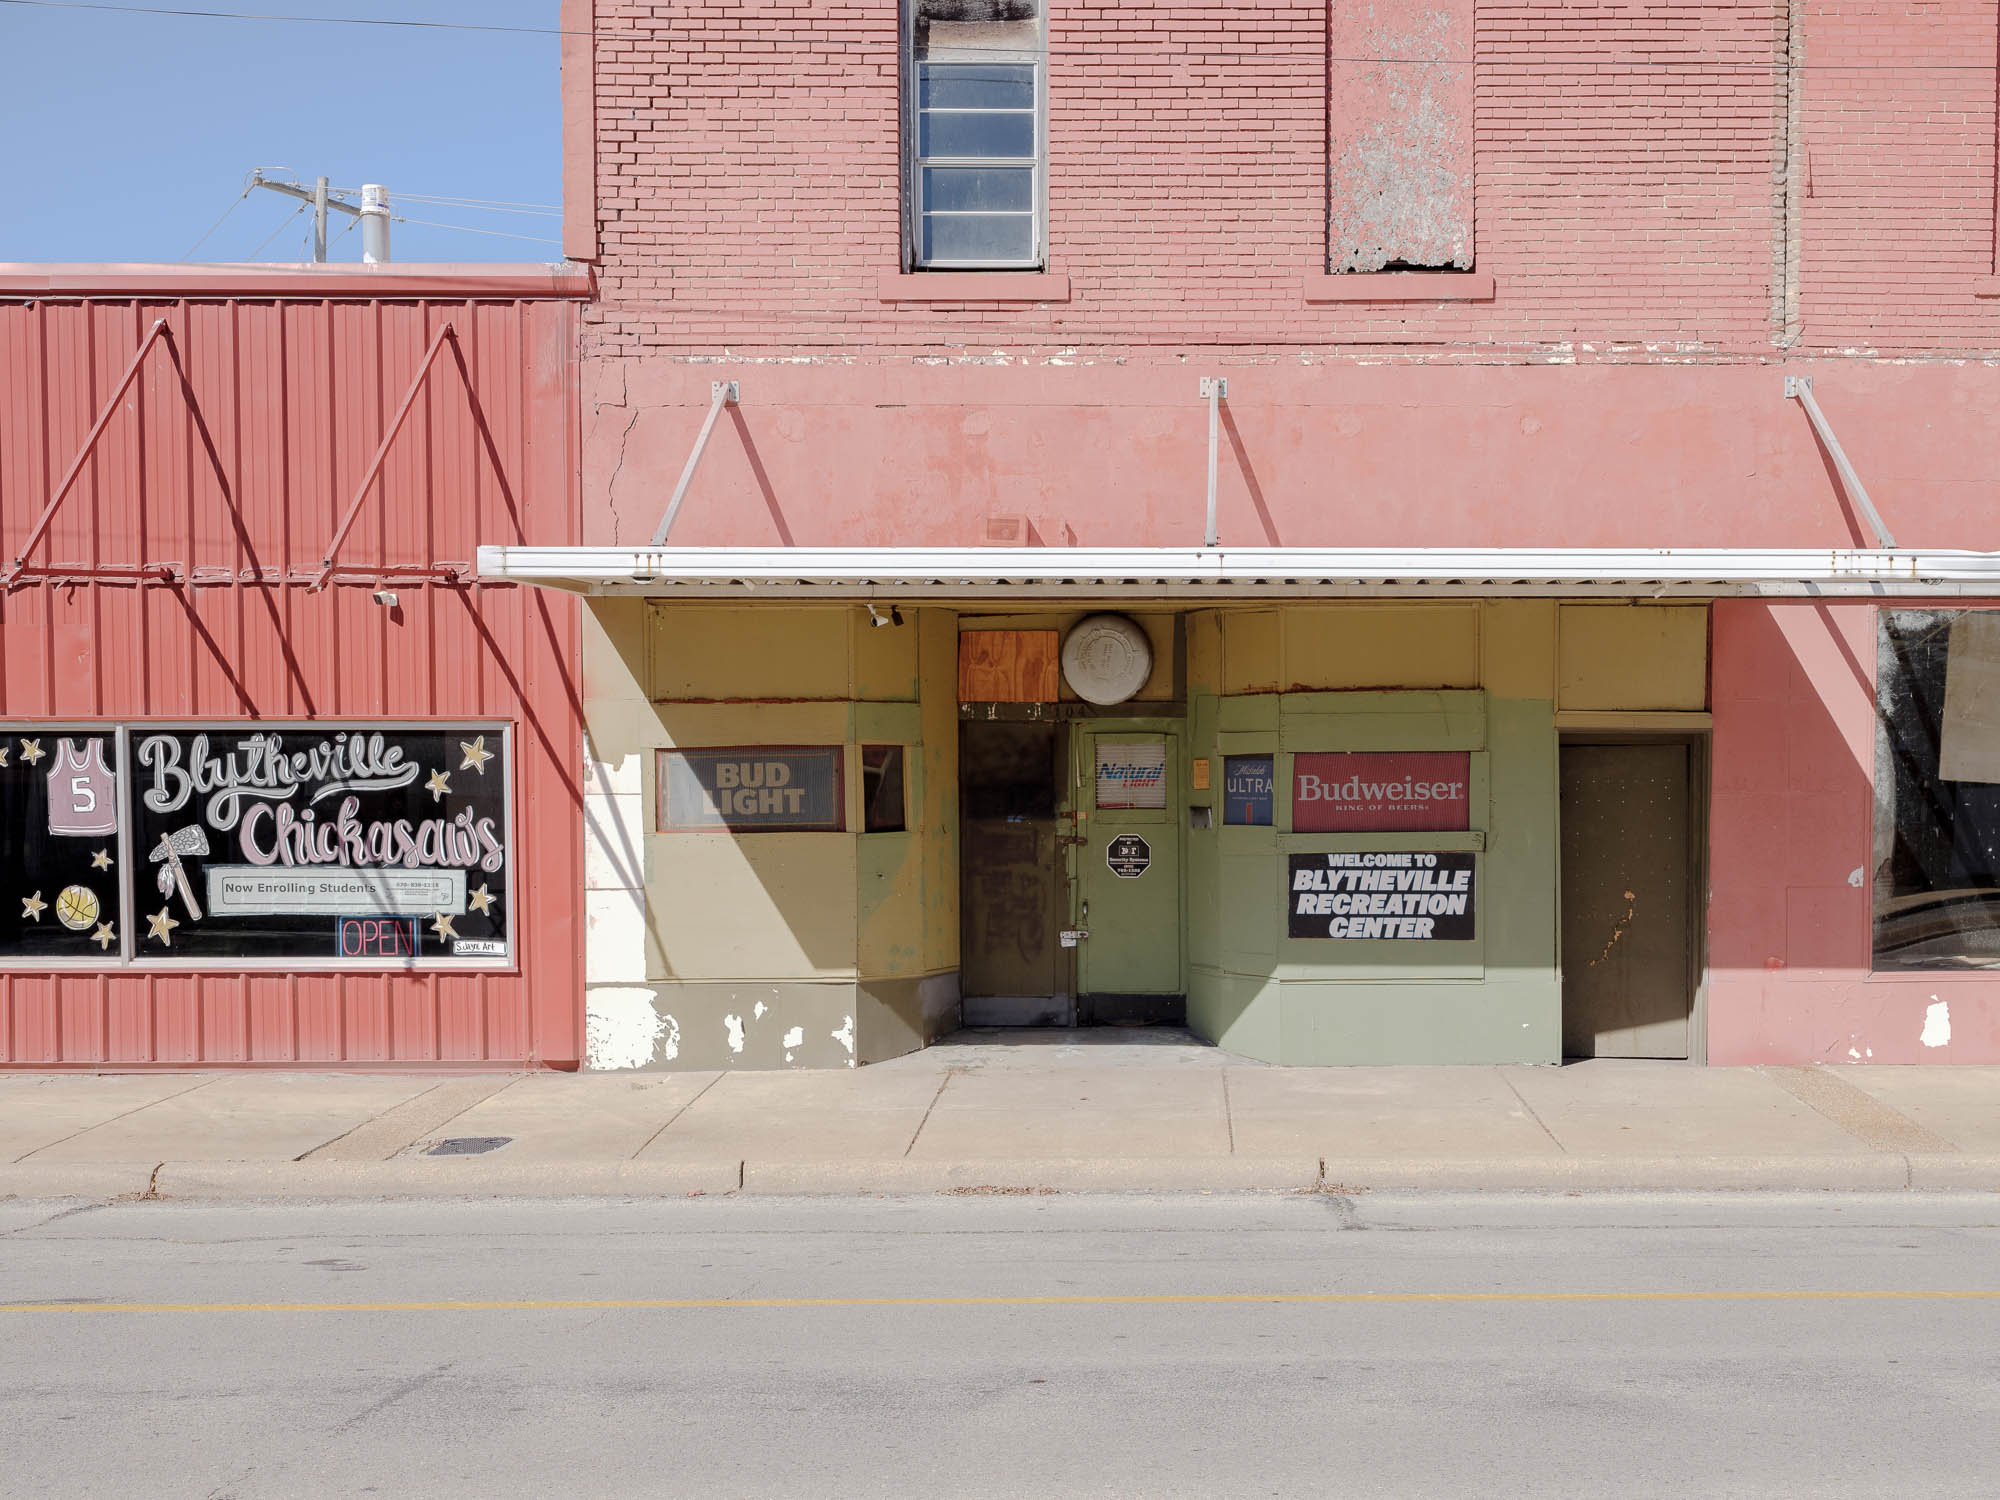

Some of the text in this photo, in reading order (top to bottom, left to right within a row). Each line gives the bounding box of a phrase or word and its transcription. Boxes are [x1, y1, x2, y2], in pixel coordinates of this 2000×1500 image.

[138, 732, 419, 831] Blytheville
[716, 762, 790, 788] BUD
[1097, 763, 1164, 779] Natural
[71, 776, 97, 813] 5
[1227, 777, 1273, 793] ULTRA
[1298, 775, 1464, 801] Budweiser
[703, 788, 805, 815] LIGHT
[239, 796, 503, 872] Chickasaws
[1328, 854, 1437, 867] WELCOME TO
[225, 883, 253, 893] Now
[258, 883, 316, 895] Enrolling
[319, 883, 376, 893] Students
[1293, 869, 1471, 891] BLYTHEVILLE
[1296, 893, 1468, 915] RECREATION
[342, 920, 413, 956] OPEN
[1328, 917, 1435, 939] CENTER
[482, 942, 495, 951] Art
